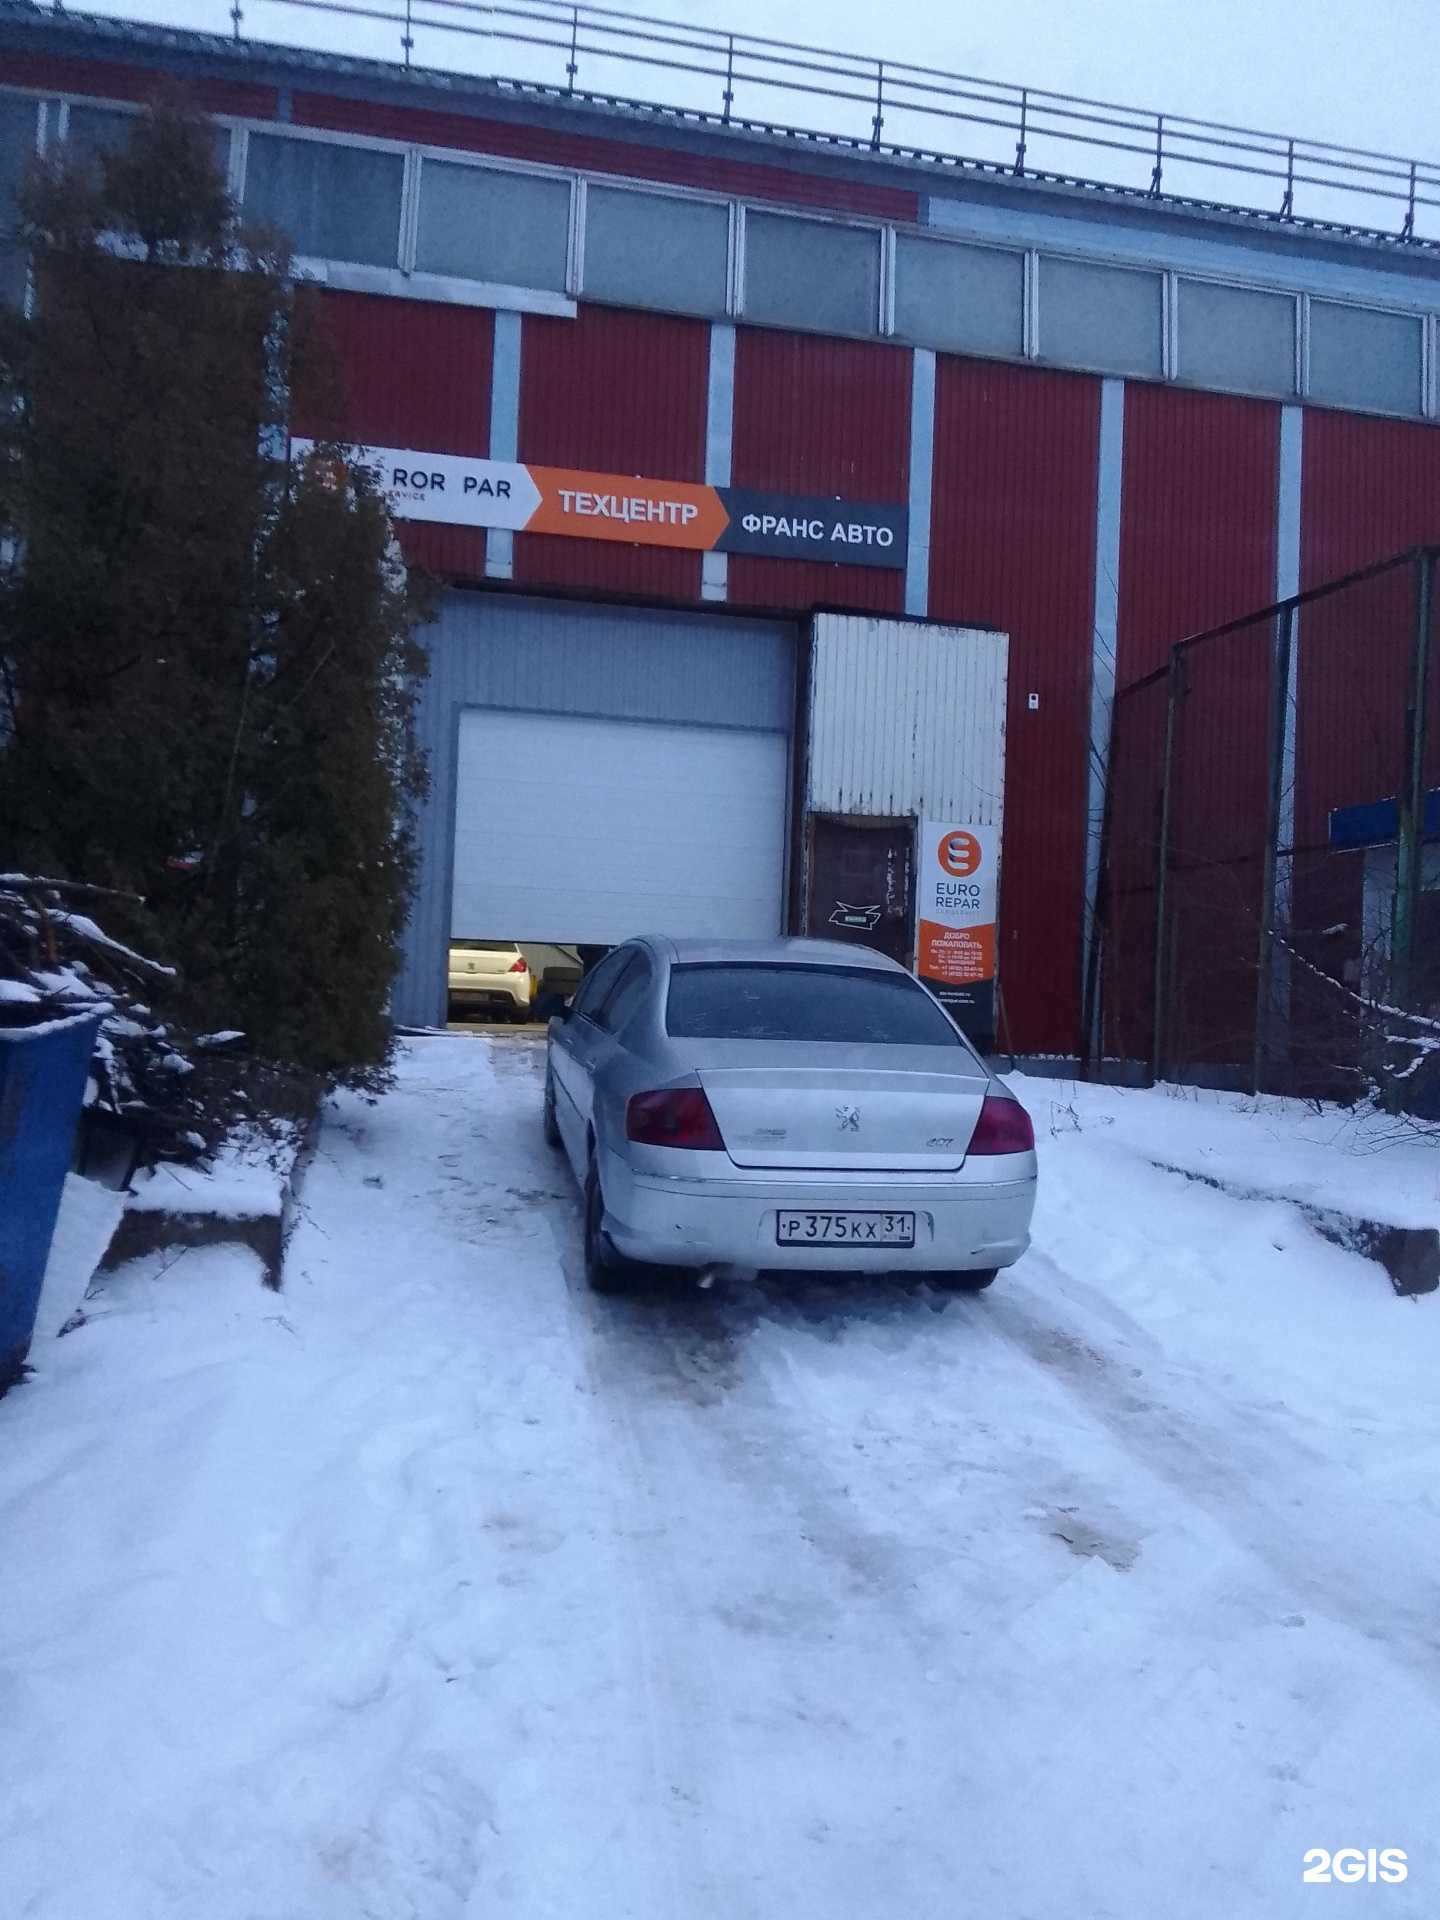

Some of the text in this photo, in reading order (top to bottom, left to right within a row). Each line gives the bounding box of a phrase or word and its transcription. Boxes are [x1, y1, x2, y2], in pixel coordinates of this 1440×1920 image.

[463, 475, 511, 499] PAR
[558, 489, 698, 525] ТЕХЦЕНТР
[741, 513, 894, 547] ФРАНС АВТО
[936, 882, 980, 897] EURO
[935, 896, 980, 910] REPAR
[884, 1215, 906, 1233] 31
